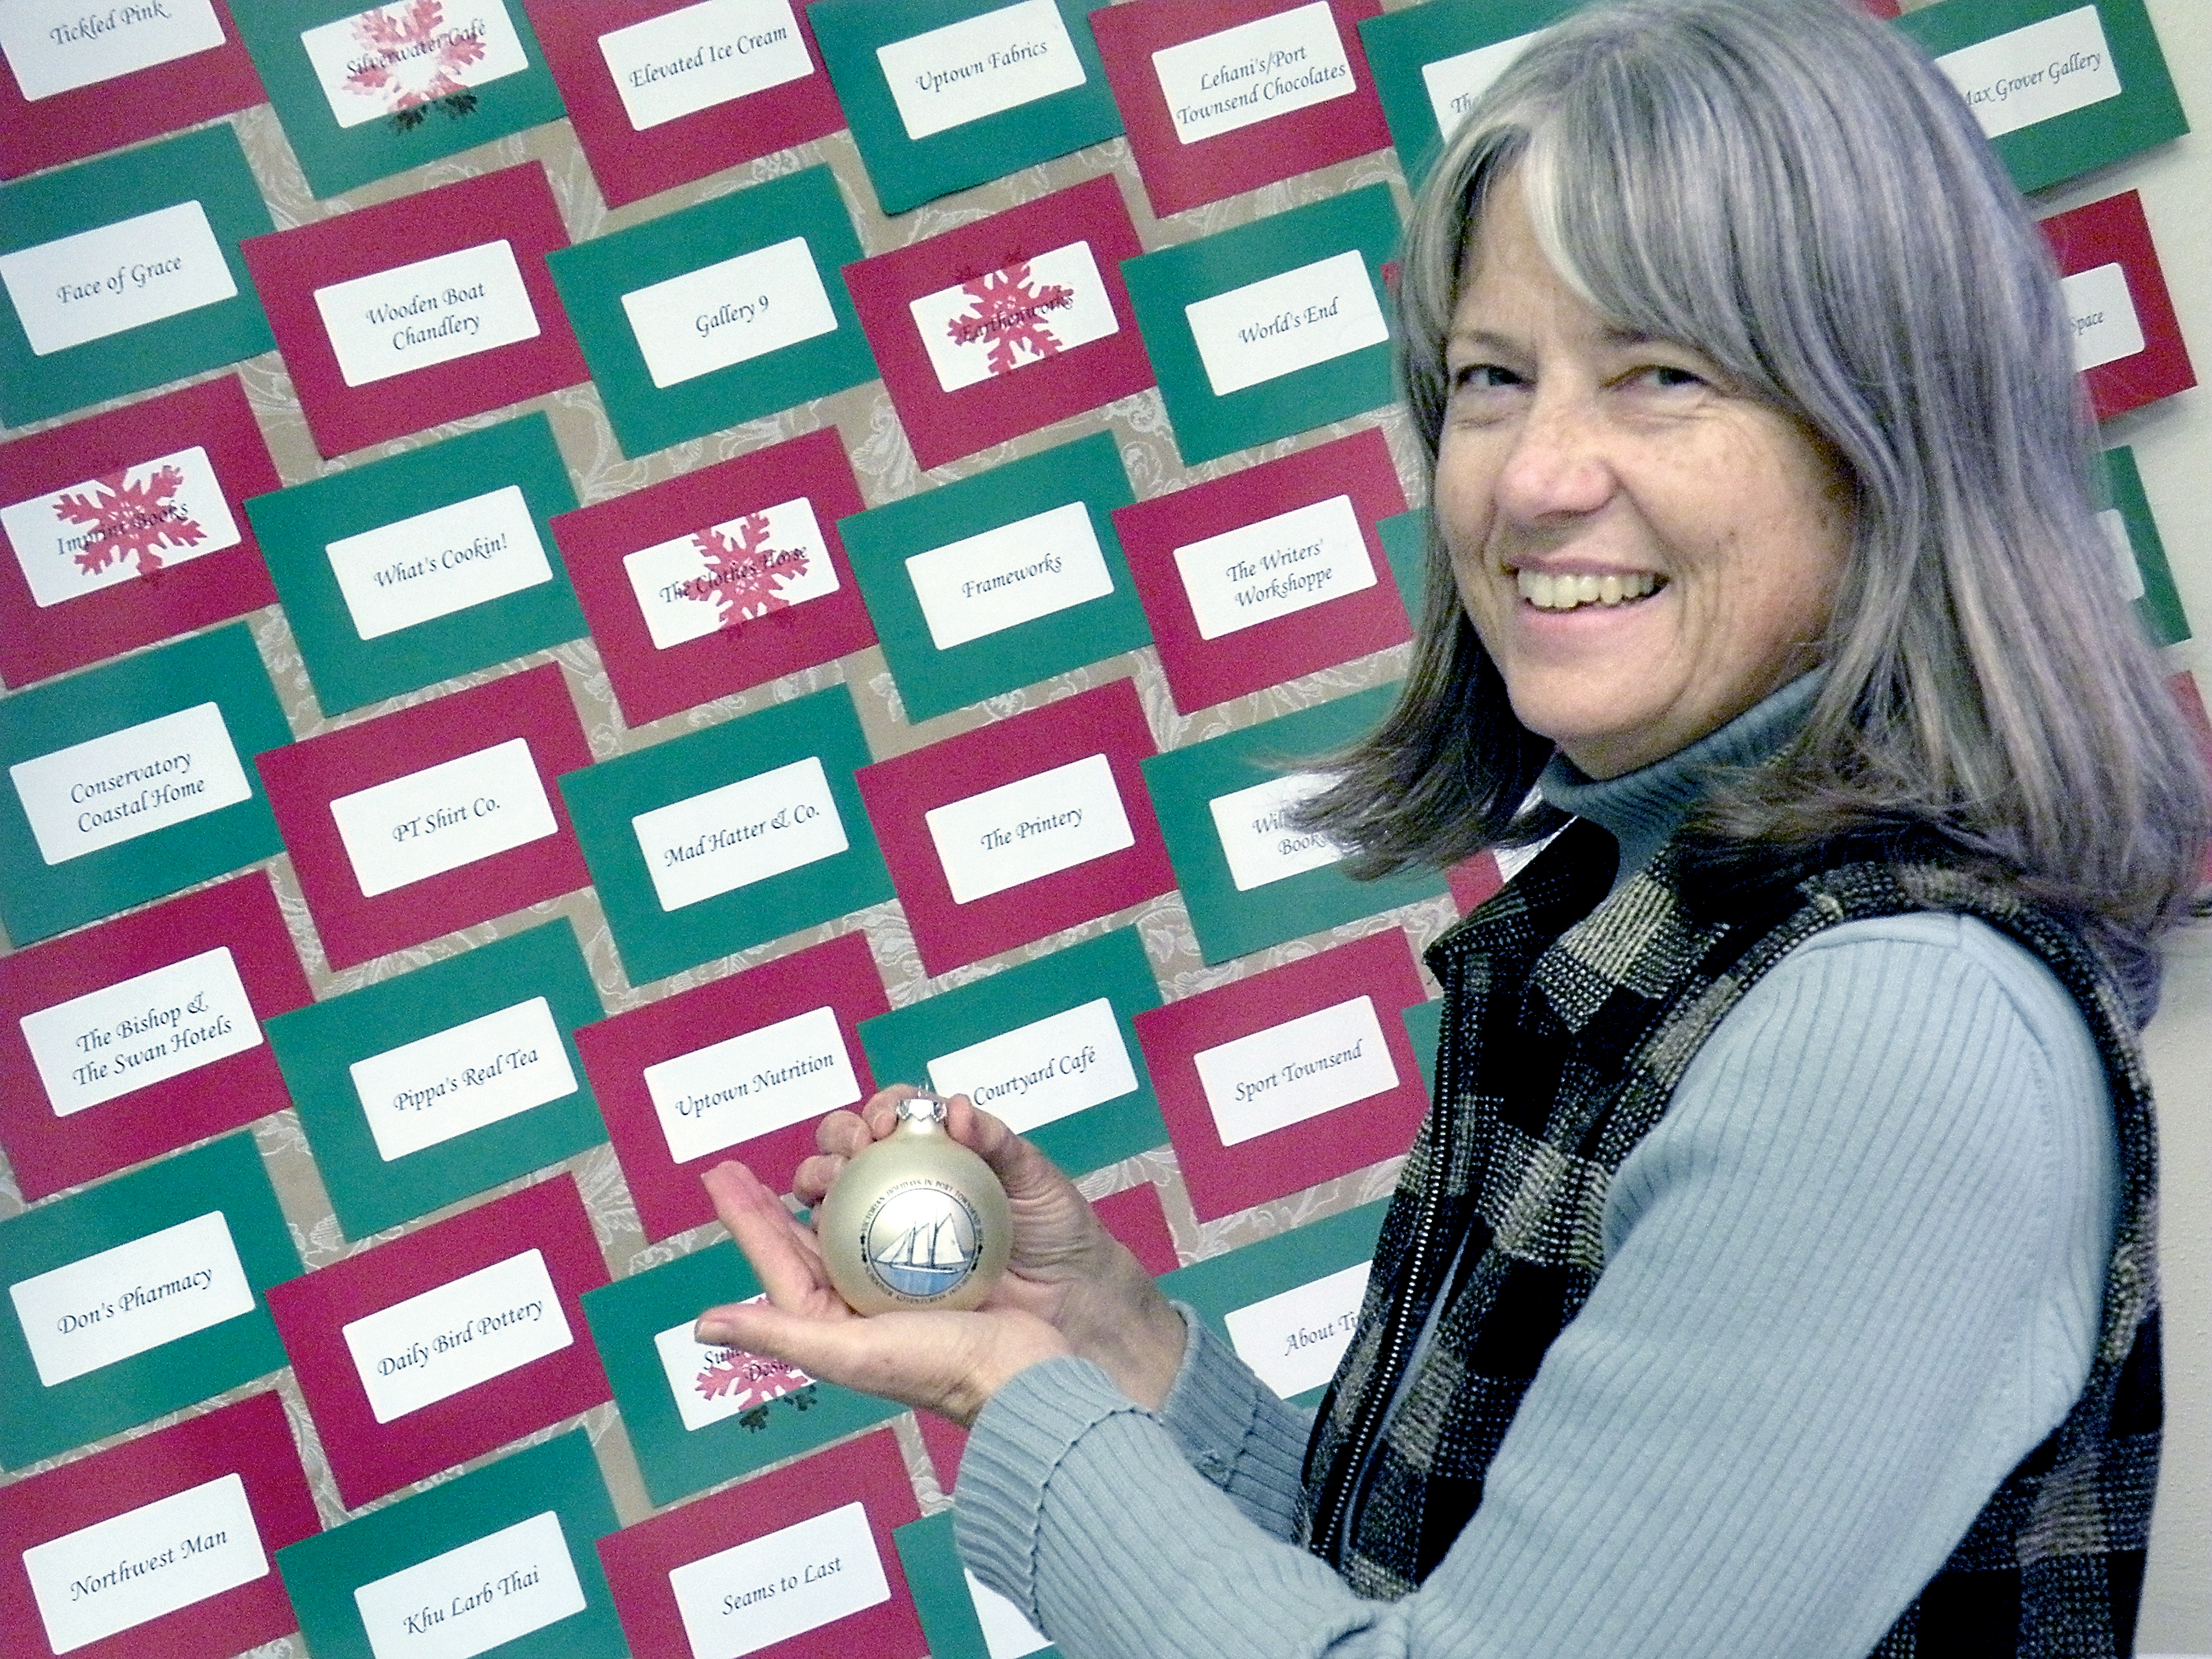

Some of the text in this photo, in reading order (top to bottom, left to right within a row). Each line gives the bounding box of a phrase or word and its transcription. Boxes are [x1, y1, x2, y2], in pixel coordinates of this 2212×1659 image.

[49, 0, 169, 45] Tickled Pink
[346, 18, 486, 78] Silverwater Café
[629, 27, 788, 88] Elevated Ice Cream
[915, 42, 1048, 93] Uptown Fabrics
[1201, 45, 1308, 92] Lehani's/Port
[1996, 69, 2044, 101] Grover
[2048, 52, 2100, 84] Gallery
[1176, 61, 1347, 125] Townsend Chocolates
[57, 257, 181, 304] Face of Grace
[366, 283, 485, 325] Wooden Boat
[392, 314, 480, 350] Chandlery
[695, 295, 769, 338] Gallery 9
[1238, 296, 1339, 344] World's End
[58, 499, 189, 554] Imprint Books
[374, 532, 508, 588] What's Cookin!
[659, 546, 808, 602] The Clothes Horse
[962, 552, 1062, 598] Frameworks
[1225, 538, 1323, 582] The Writers'
[1234, 566, 1333, 608] Workshoppe
[70, 752, 192, 804] Conservatory
[78, 779, 204, 833] Coastal Home
[393, 797, 501, 842] PT Shirt Co.
[980, 808, 1082, 851] The Printery
[664, 804, 820, 868] Mad Hatter & Co.
[76, 991, 209, 1053] The Bishop &
[72, 1014, 232, 1086] The Swan Hotels
[971, 1045, 1096, 1109] Courtyard Café
[1235, 1038, 1363, 1102] Sport Townsend
[394, 1048, 538, 1111] Pippa's Real Tea
[675, 1054, 834, 1118] Uptown Nutrition
[936, 1180, 953, 1192] PORT
[57, 1269, 212, 1335] Don's Pharmacy
[377, 1300, 542, 1376] Daily Bird Pottery
[1284, 1322, 1335, 1356] About
[70, 1530, 227, 1602] Northwest Man
[722, 1557, 842, 1616] Seams to Last
[403, 1564, 540, 1635] Khu Larb Thai
